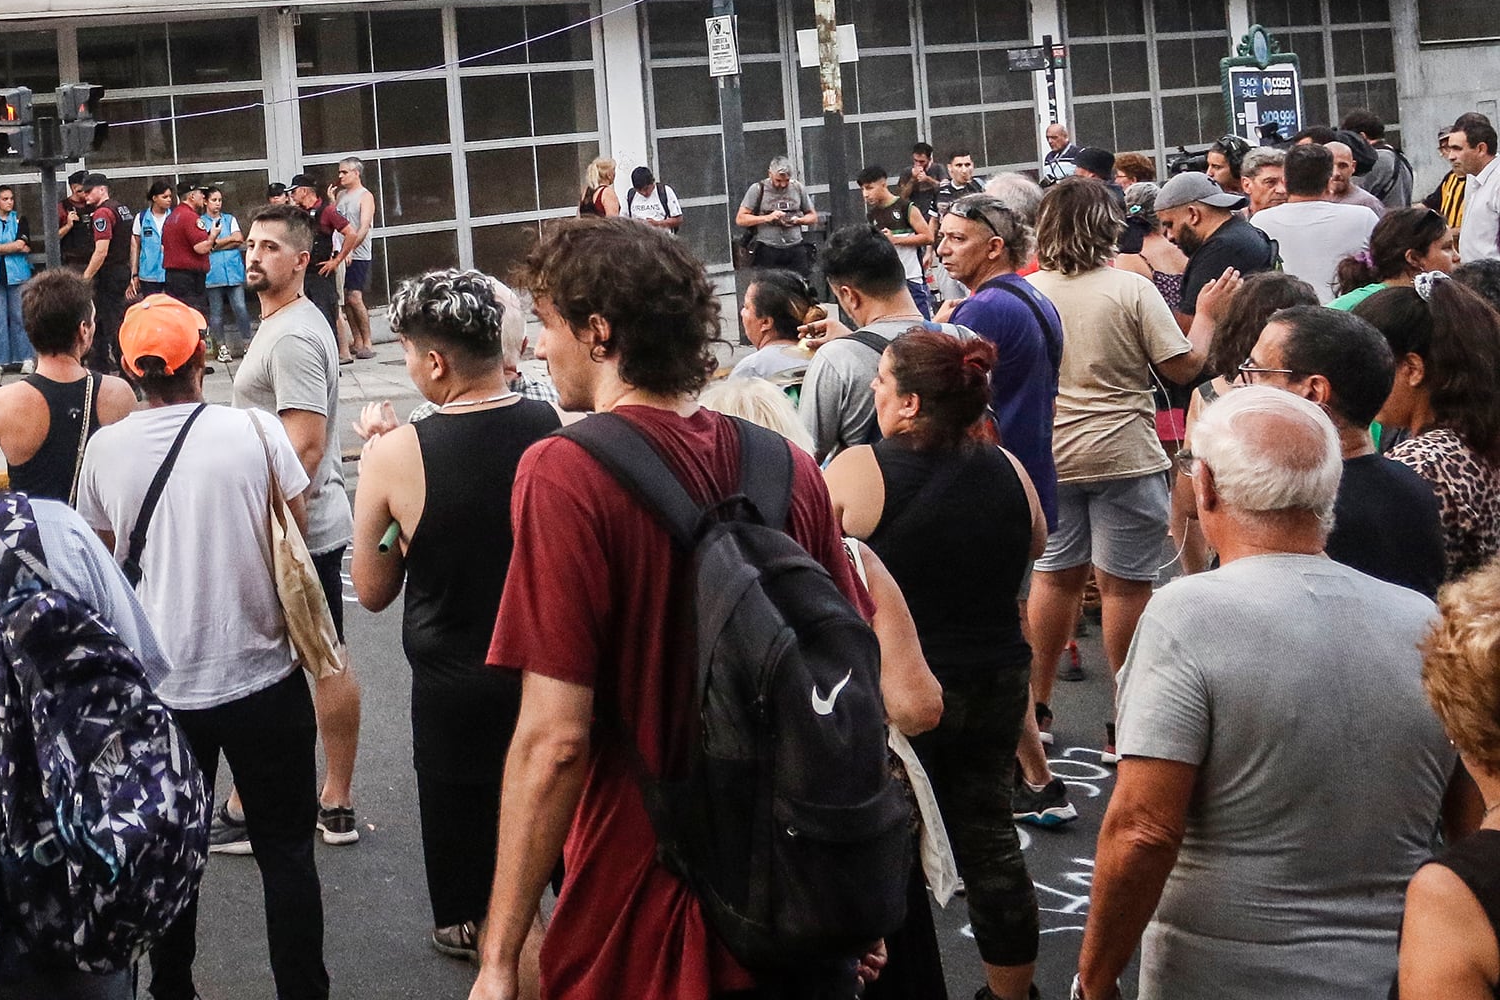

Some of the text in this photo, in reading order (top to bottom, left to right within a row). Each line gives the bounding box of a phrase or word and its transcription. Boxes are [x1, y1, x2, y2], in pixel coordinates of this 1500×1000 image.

[1238, 77, 1259, 87] BLACK
[1271, 77, 1291, 88] casa
[1242, 88, 1258, 98] SALE
